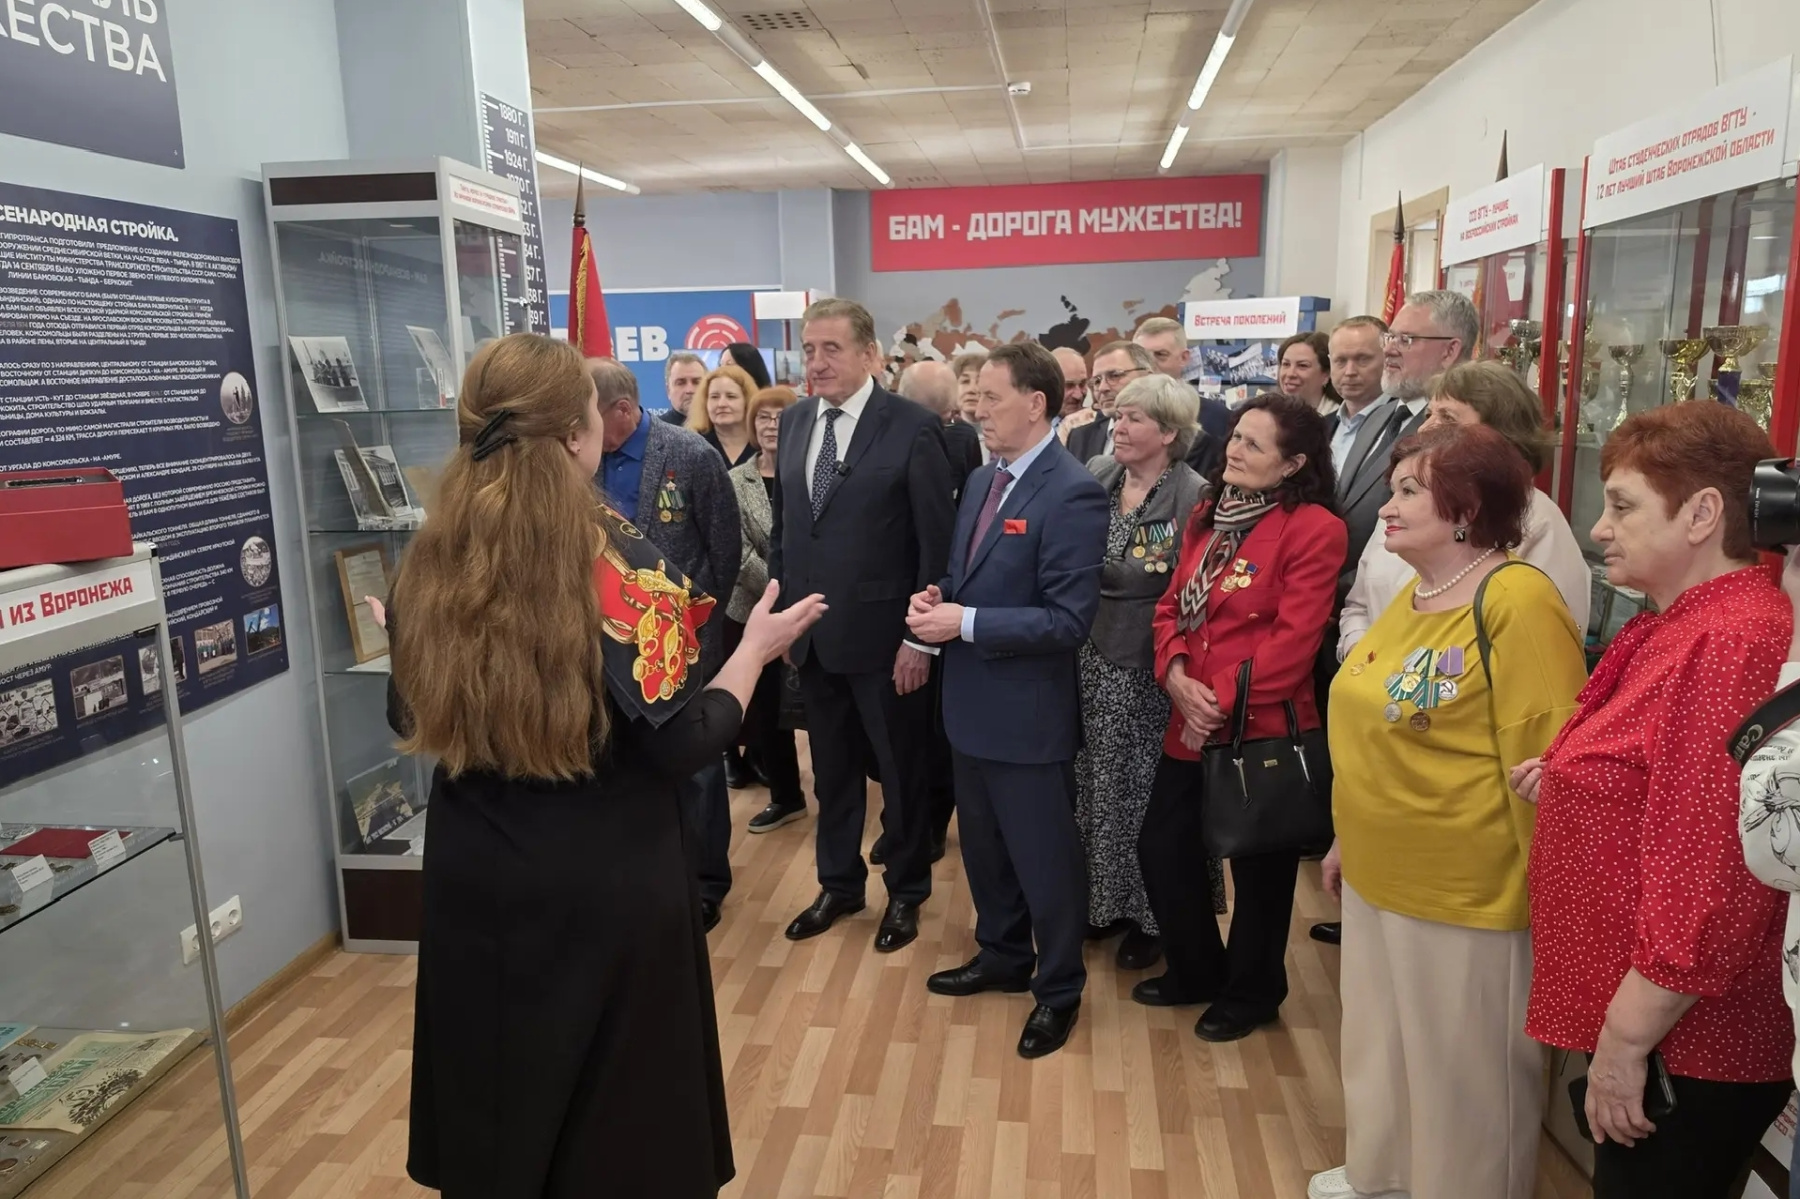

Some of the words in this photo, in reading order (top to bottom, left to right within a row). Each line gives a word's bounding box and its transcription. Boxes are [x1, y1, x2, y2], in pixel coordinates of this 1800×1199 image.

[0, 0, 167, 83] ЕСТВА
[499, 103, 517, 123] 1880
[1721, 106, 1748, 133] ВГТУ
[504, 149, 522, 169] 1924
[1596, 183, 1604, 200] 12
[889, 215, 944, 241] БАМ
[966, 210, 1072, 241] ДОРОГА
[1079, 202, 1243, 234] МУЖЕСТВА!
[109, 219, 178, 241] СТРОЙКА.
[15, 252, 55, 262] ИНСТИТУТЫ
[56, 256, 104, 267] МИНИСТЕРСТВА
[20, 262, 54, 271] СЕНТЯБРЯ
[74, 267, 104, 275] УЛОЖЕНО
[8, 272, 32, 280] ЛИНИИ
[33, 273, 73, 282] БАМОВСКАЯ
[27, 402, 75, 410] СТРОИТЕЛЬСТВО
[44, 410, 74, 418] КУЛЬТУРЫ
[5, 436, 43, 446] СОСТАВЛЯЕТ
[42, 456, 90, 467] КОМСОМОЛЬСКА
